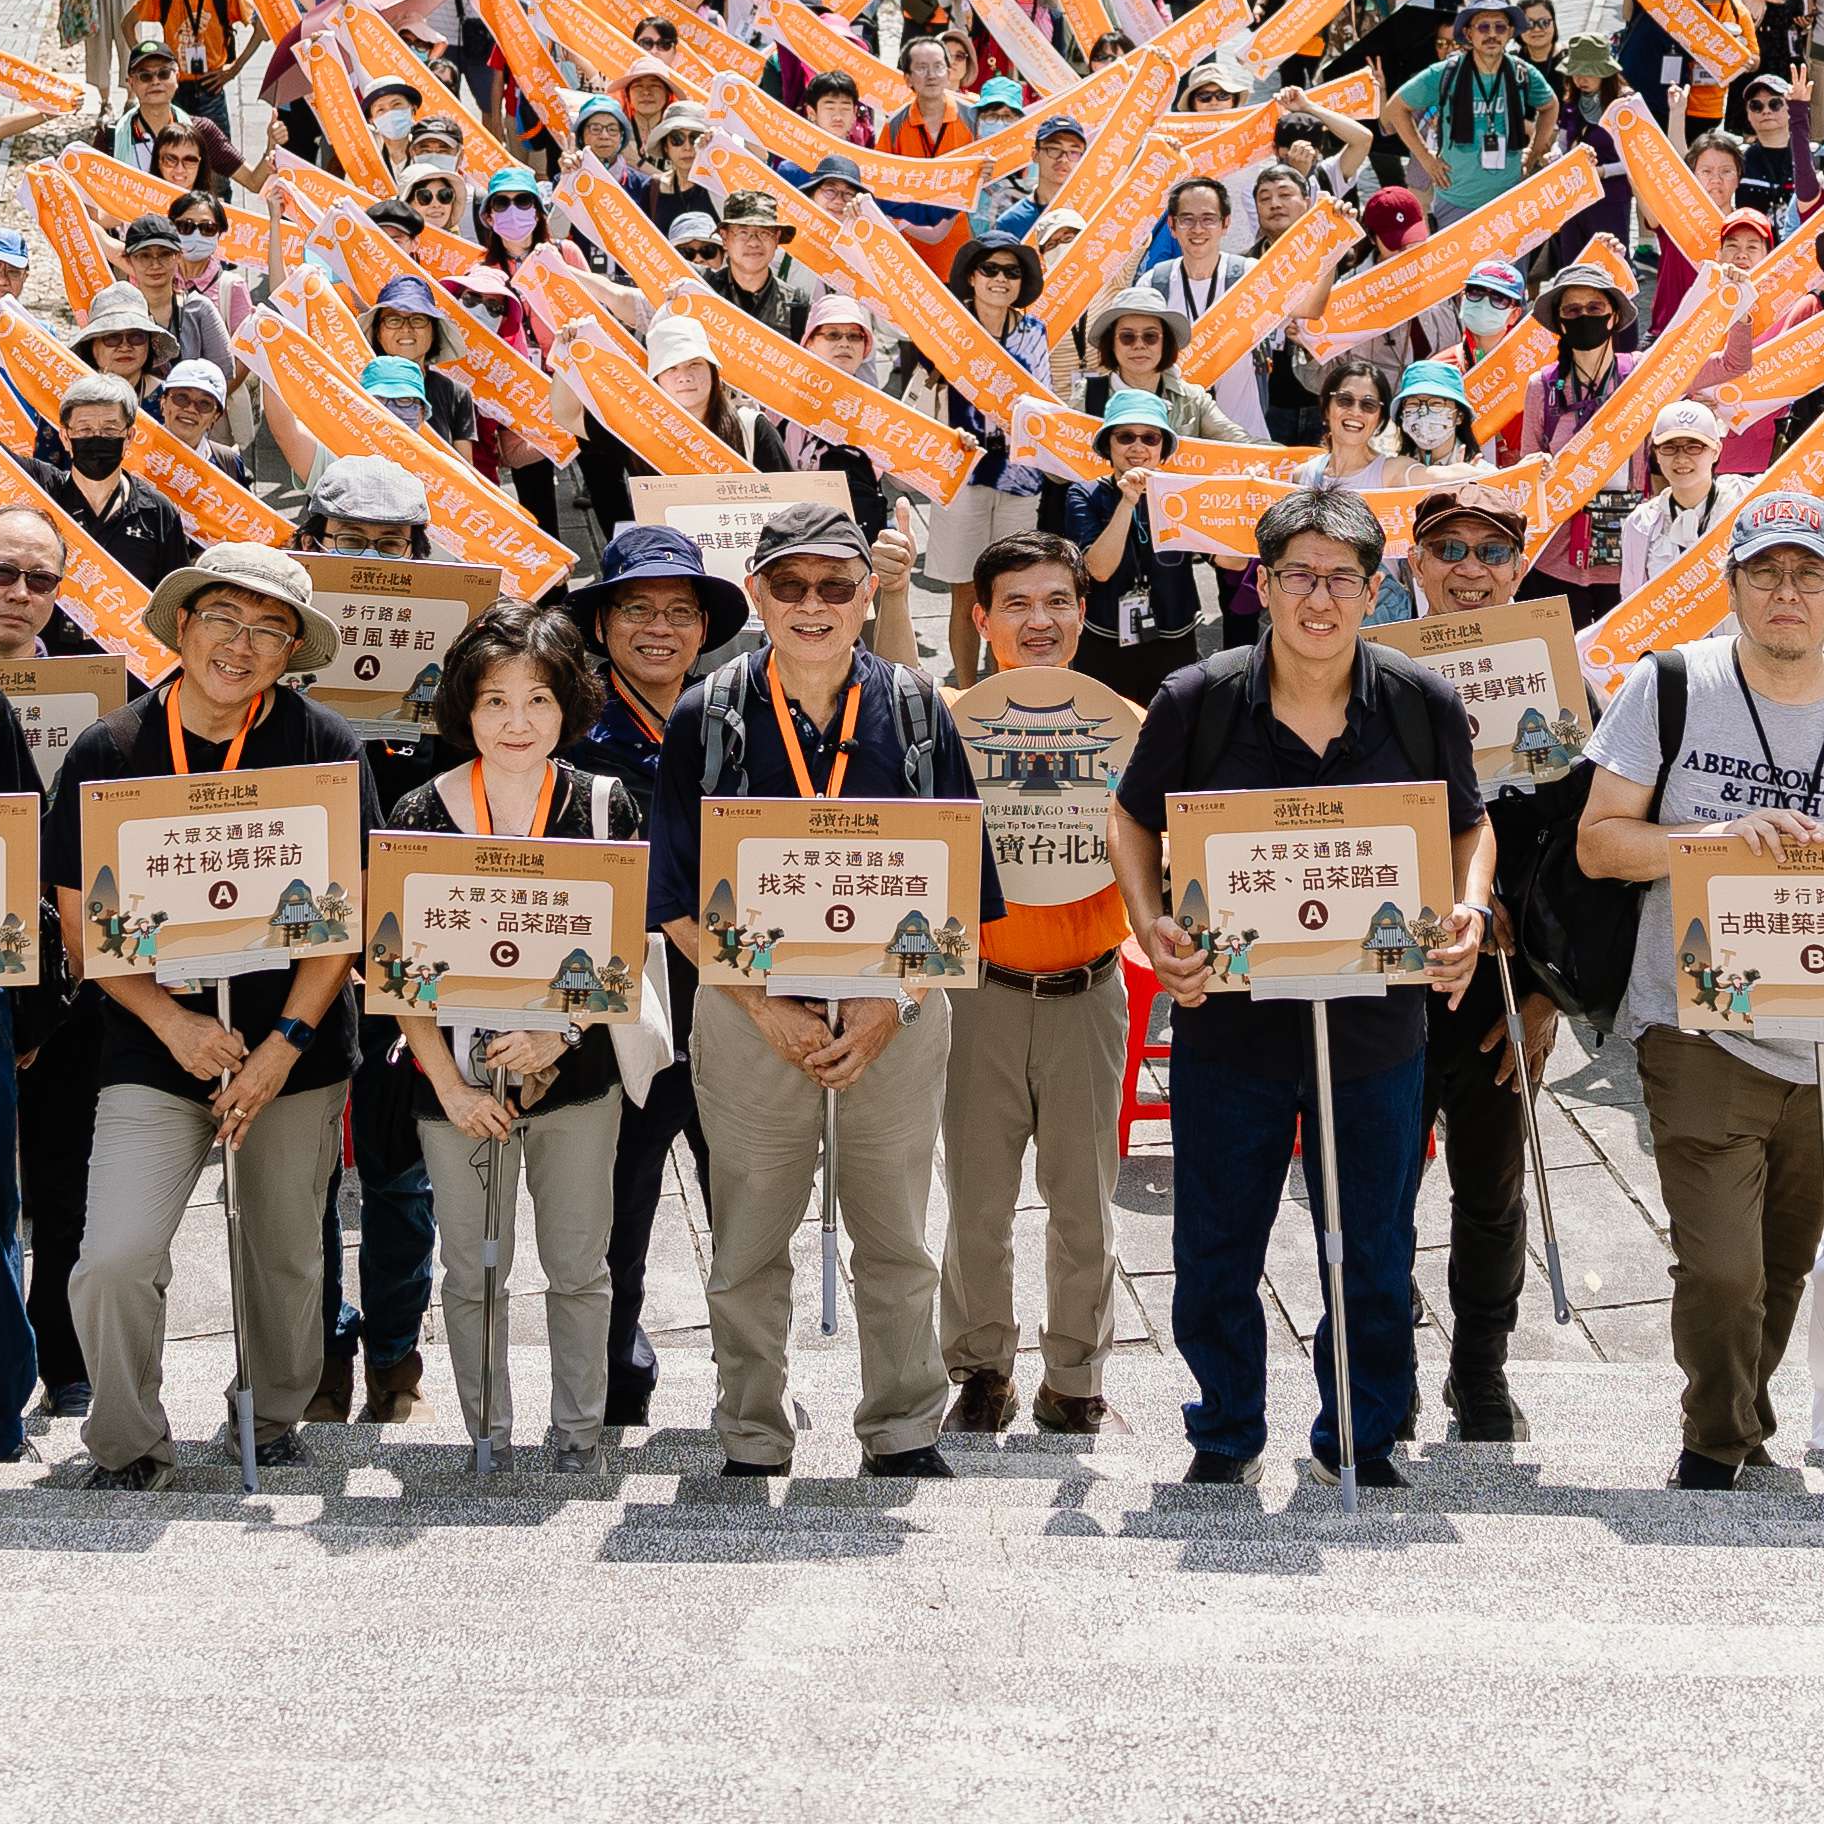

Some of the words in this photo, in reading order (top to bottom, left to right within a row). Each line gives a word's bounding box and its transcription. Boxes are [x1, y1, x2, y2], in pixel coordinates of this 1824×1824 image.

[1470, 165, 1588, 254] 尋寶台北城
[832, 391, 965, 479] 尋寶台北城
[145, 447, 278, 544] 尋寶台北城
[1753, 500, 1821, 532] TOKYO
[350, 572, 412, 586] 尋寶台北城
[342, 604, 412, 623] 步行路線
[1420, 623, 1482, 644] 尋寶台北城
[360, 661, 375, 676] A
[1428, 658, 1495, 679] 行路線
[188, 784, 258, 802] 尋寶台北城
[1720, 782, 1742, 803] &
[1273, 800, 1344, 818] 尋寶台北城
[1694, 806, 1718, 821] REG.
[809, 812, 879, 827] 尋寶台北城
[1007, 822, 1019, 831] Tip
[1021, 822, 1036, 830] Toe
[1038, 822, 1056, 830] Time
[1058, 821, 1093, 832] Traveling
[163, 821, 285, 846] 大眾交通路線
[146, 843, 303, 878] 神社秘境探訪
[475, 851, 544, 867] 尋寶台北城
[783, 850, 905, 867] 大眾交通路線
[1251, 840, 1373, 862] 大眾交通路線
[758, 873, 928, 897] 找茶、品茶踏查
[1228, 864, 1399, 894] 找茶、品茶踏查
[215, 886, 232, 904] A
[449, 886, 569, 907] 大眾交通路線
[424, 908, 593, 935] 找茶、品茶踏查
[833, 910, 849, 927] B
[1304, 905, 1323, 924] A
[497, 945, 513, 963] C
[1808, 951, 1824, 968] B
